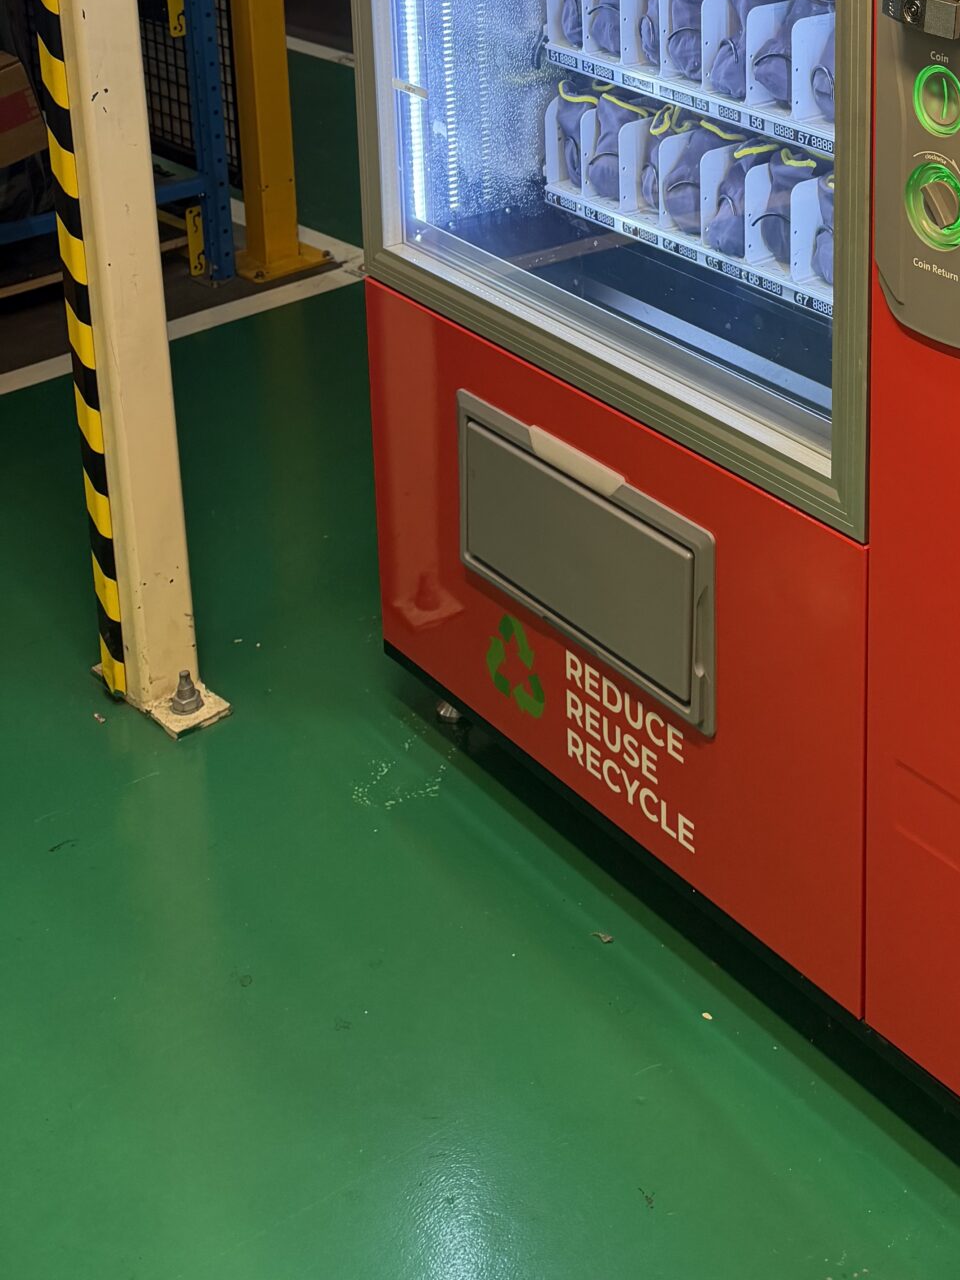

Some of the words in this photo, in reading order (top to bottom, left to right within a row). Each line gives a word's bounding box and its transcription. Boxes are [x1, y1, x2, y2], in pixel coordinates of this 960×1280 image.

[551, 52, 559, 61] 51
[930, 50, 949, 64] Coin
[583, 62, 593, 73] 52
[696, 99, 706, 111] 55
[752, 117, 762, 129] 56
[798, 132, 809, 145] 57
[811, 137, 833, 151] 8888
[586, 208, 595, 219] 62
[707, 257, 719, 270] 65
[913, 257, 931, 271] Coin
[932, 264, 959, 282] Return
[796, 293, 808, 306] 67
[565, 649, 684, 764] REDUCE
[566, 689, 658, 785] REUSE
[567, 727, 695, 854] RECYCLE
